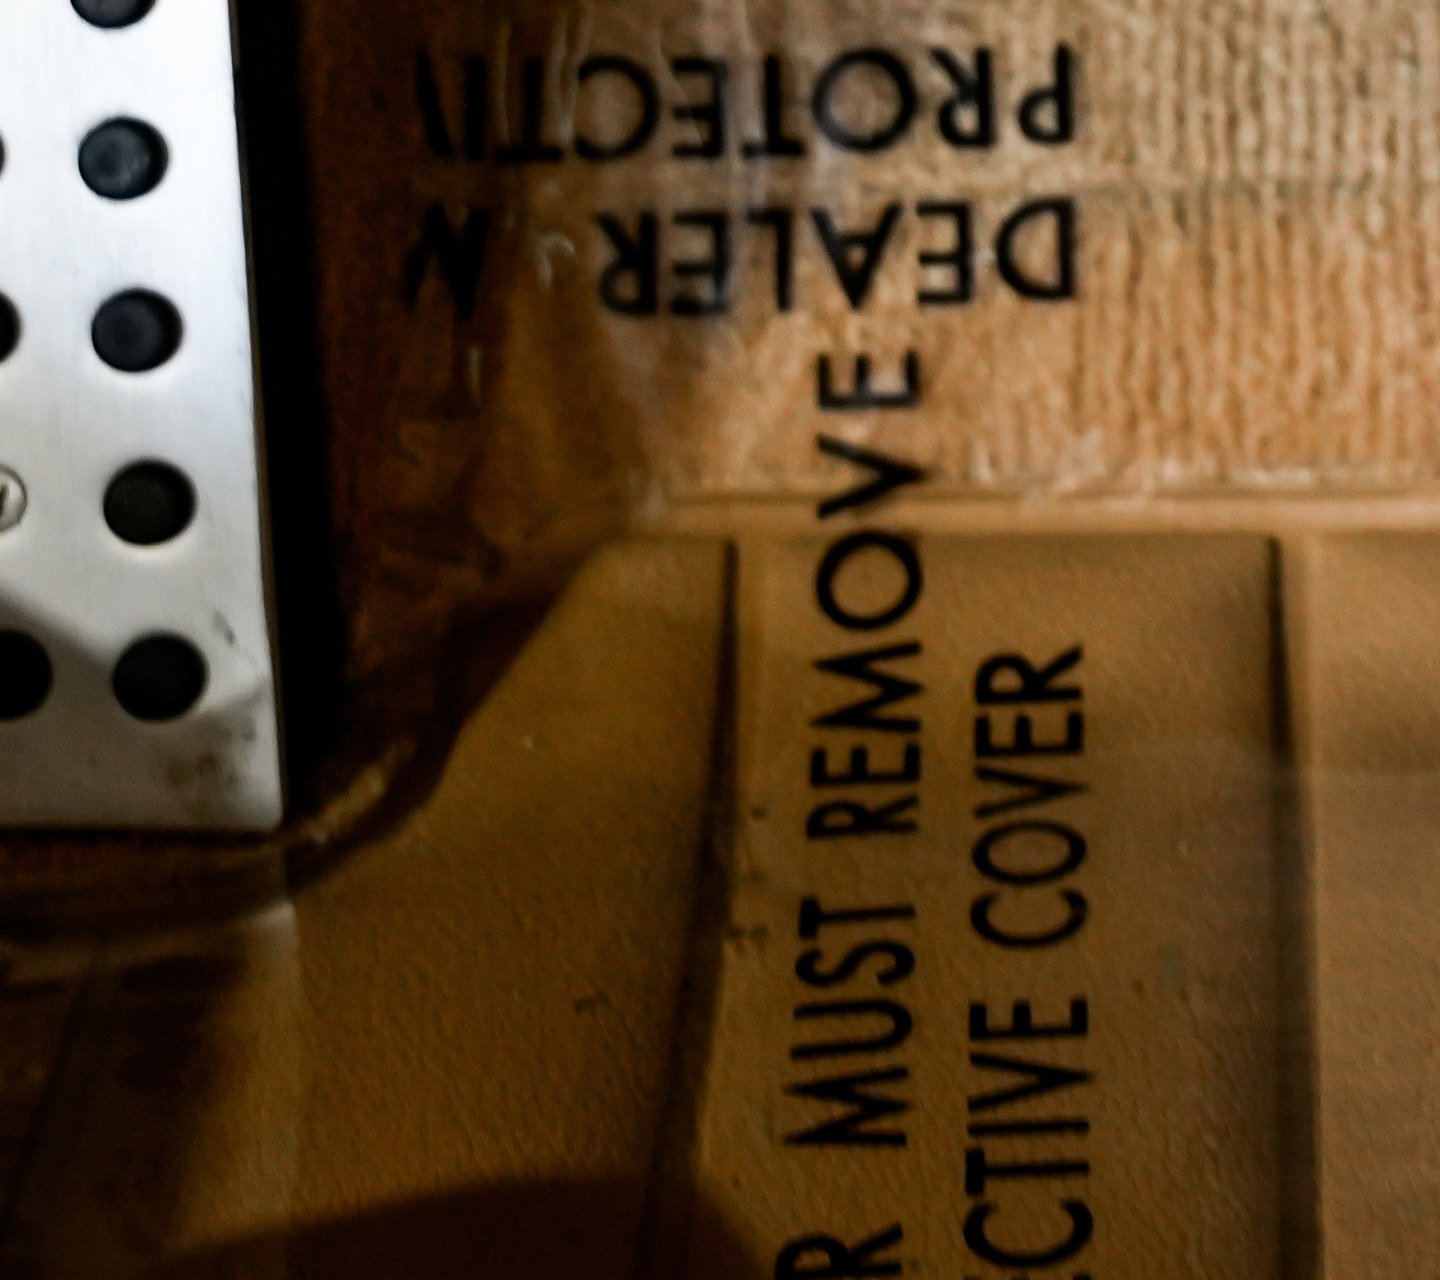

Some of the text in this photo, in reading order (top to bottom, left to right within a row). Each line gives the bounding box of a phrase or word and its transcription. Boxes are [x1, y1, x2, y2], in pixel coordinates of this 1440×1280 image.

[596, 196, 1076, 317] DEALER
[806, 348, 930, 841] REMOVE
[970, 643, 1092, 950] COVER
[782, 896, 918, 1150] MUST
